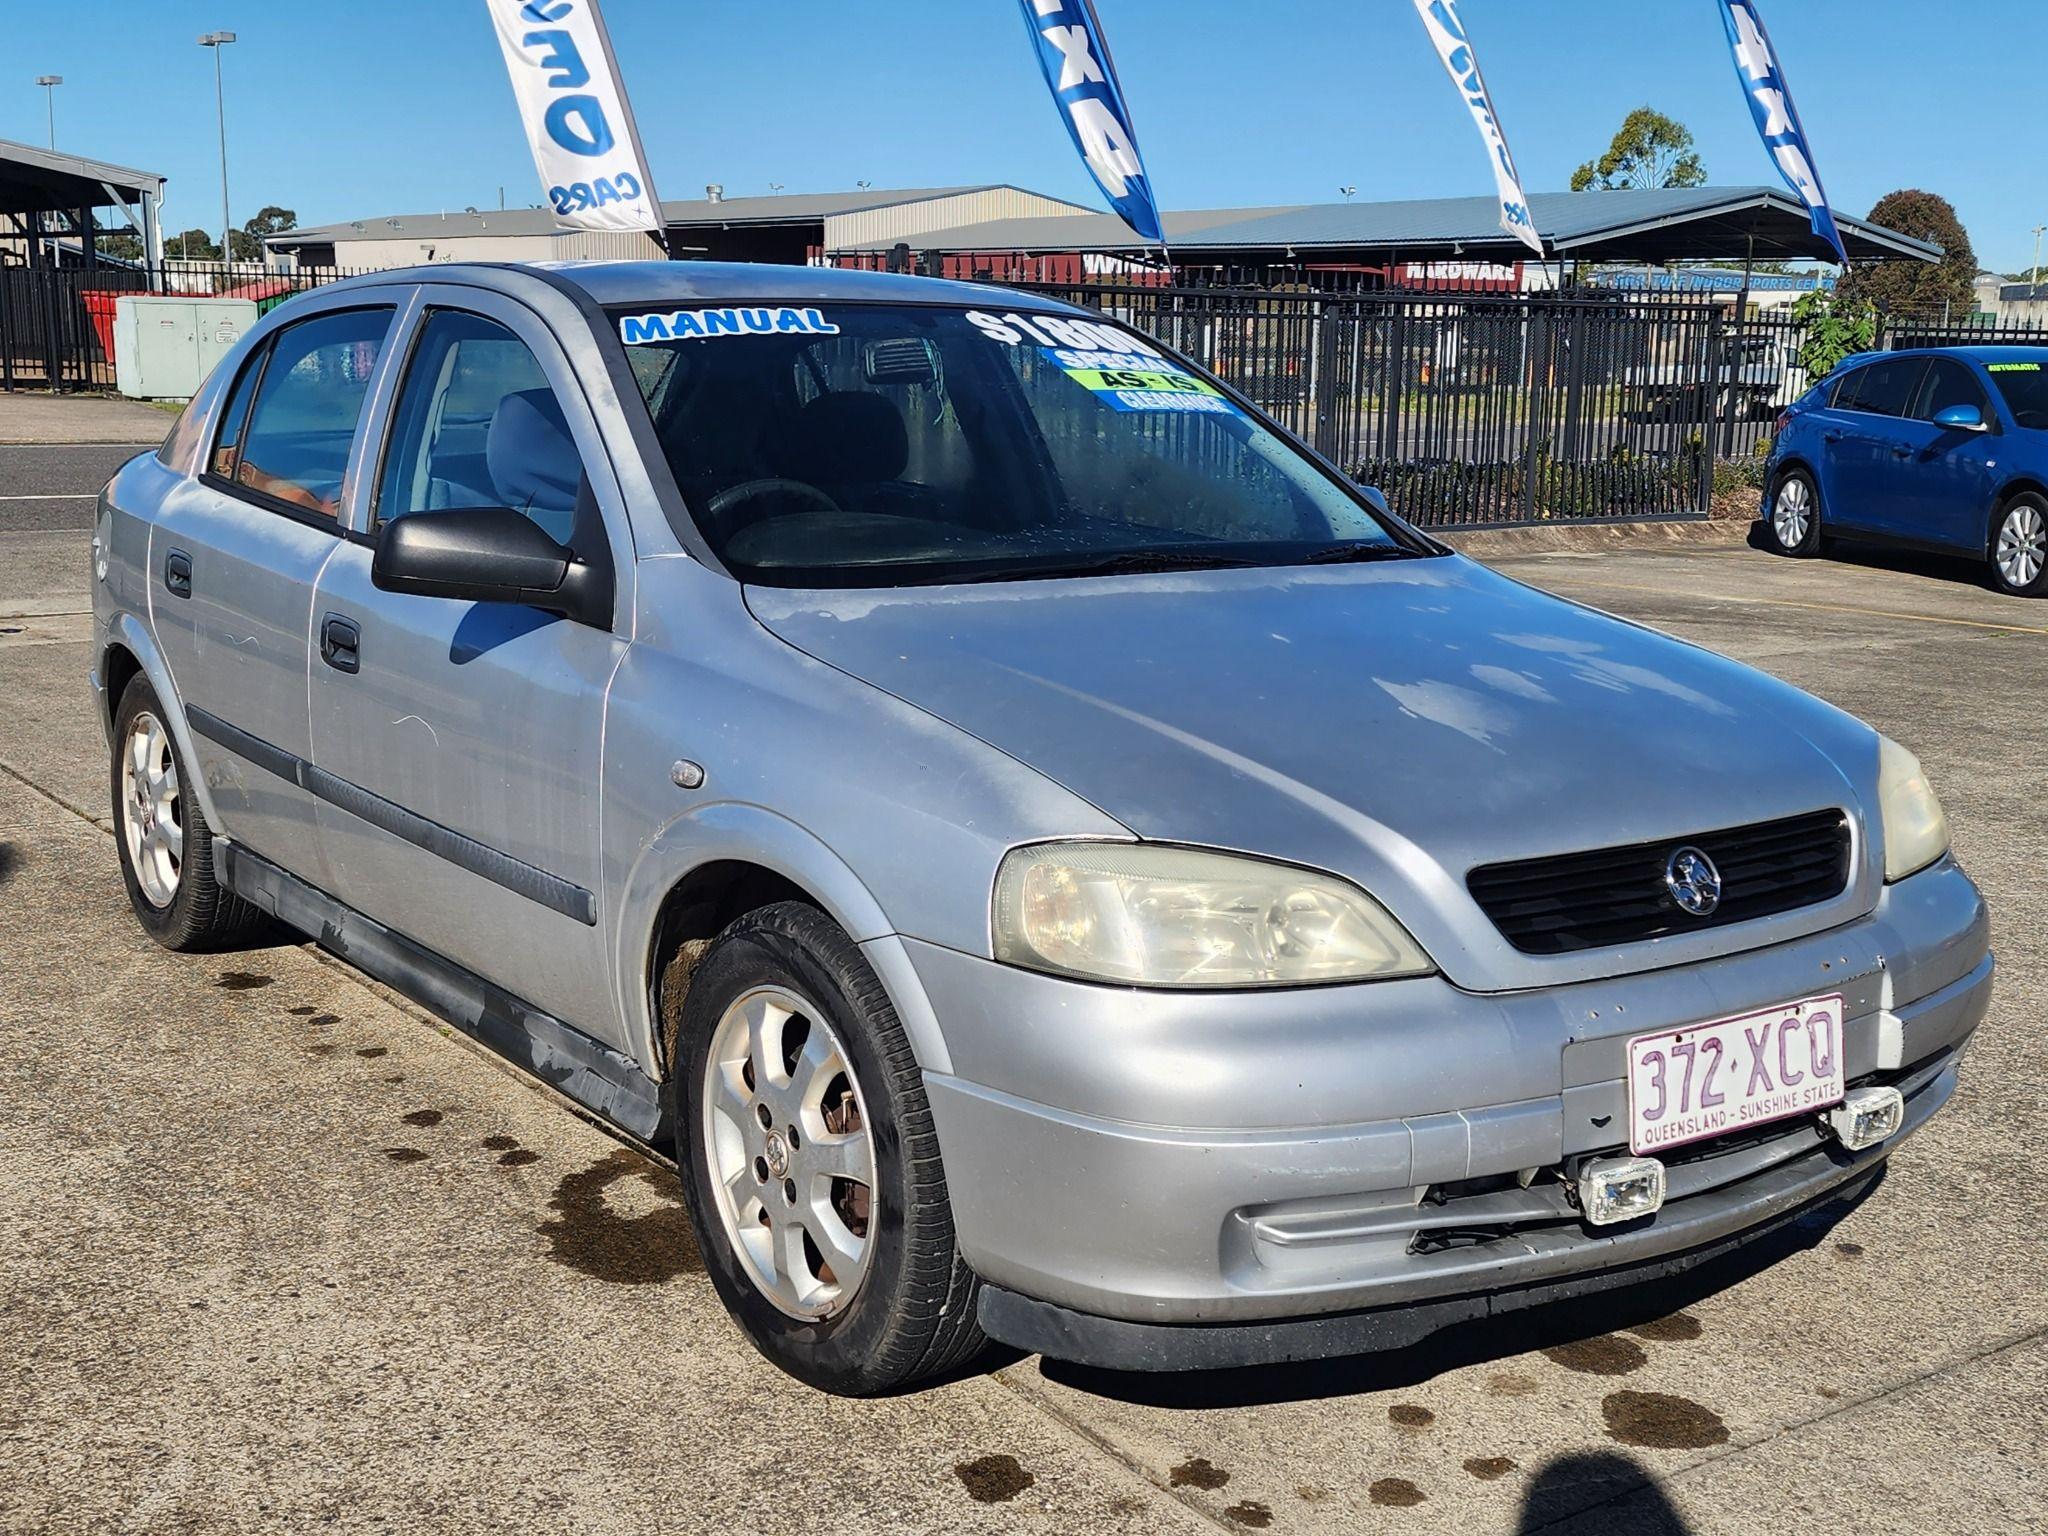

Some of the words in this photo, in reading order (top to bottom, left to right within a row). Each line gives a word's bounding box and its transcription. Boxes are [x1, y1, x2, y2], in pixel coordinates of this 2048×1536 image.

[1406, 261, 1515, 281] HARDWARE
[622, 308, 838, 343] MANUAL
[1053, 350, 1187, 375] SPECIAL
[1988, 363, 2041, 372] AUTOMATIC
[1116, 391, 1231, 414] CLEARANCE
[1645, 1112, 1727, 1144] QUEENSLAND
[1740, 1092, 1798, 1118] SUNSHINE
